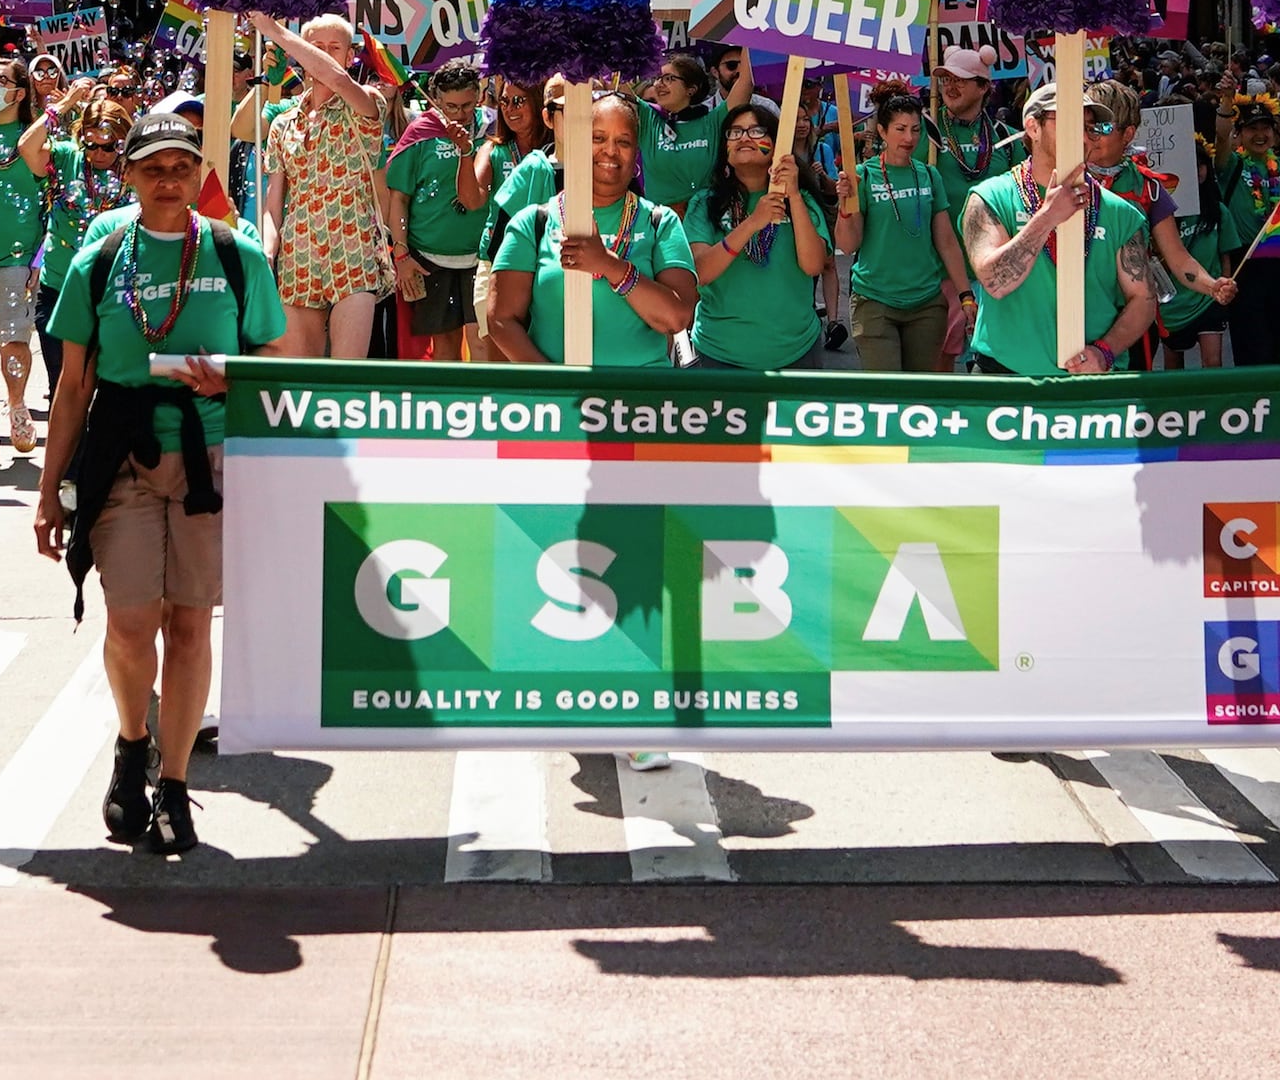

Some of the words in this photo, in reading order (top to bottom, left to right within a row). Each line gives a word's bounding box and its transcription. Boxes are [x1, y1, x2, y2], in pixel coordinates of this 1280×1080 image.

[46, 17, 70, 34] WE
[1084, 36, 1105, 50] AY
[1153, 108, 1175, 126] YOU
[258, 389, 562, 439] Washington
[578, 396, 748, 435] State’s
[766, 399, 970, 436] LGBTQ+
[986, 402, 1206, 442] Chamber
[1219, 399, 1270, 435] of
[354, 536, 968, 643] GSBA
[1210, 580, 1280, 593] CAPITOL
[352, 688, 503, 712] EQUALITY
[515, 689, 543, 711] IS
[555, 689, 641, 711] GOOD
[653, 689, 800, 711] BUSINESS
